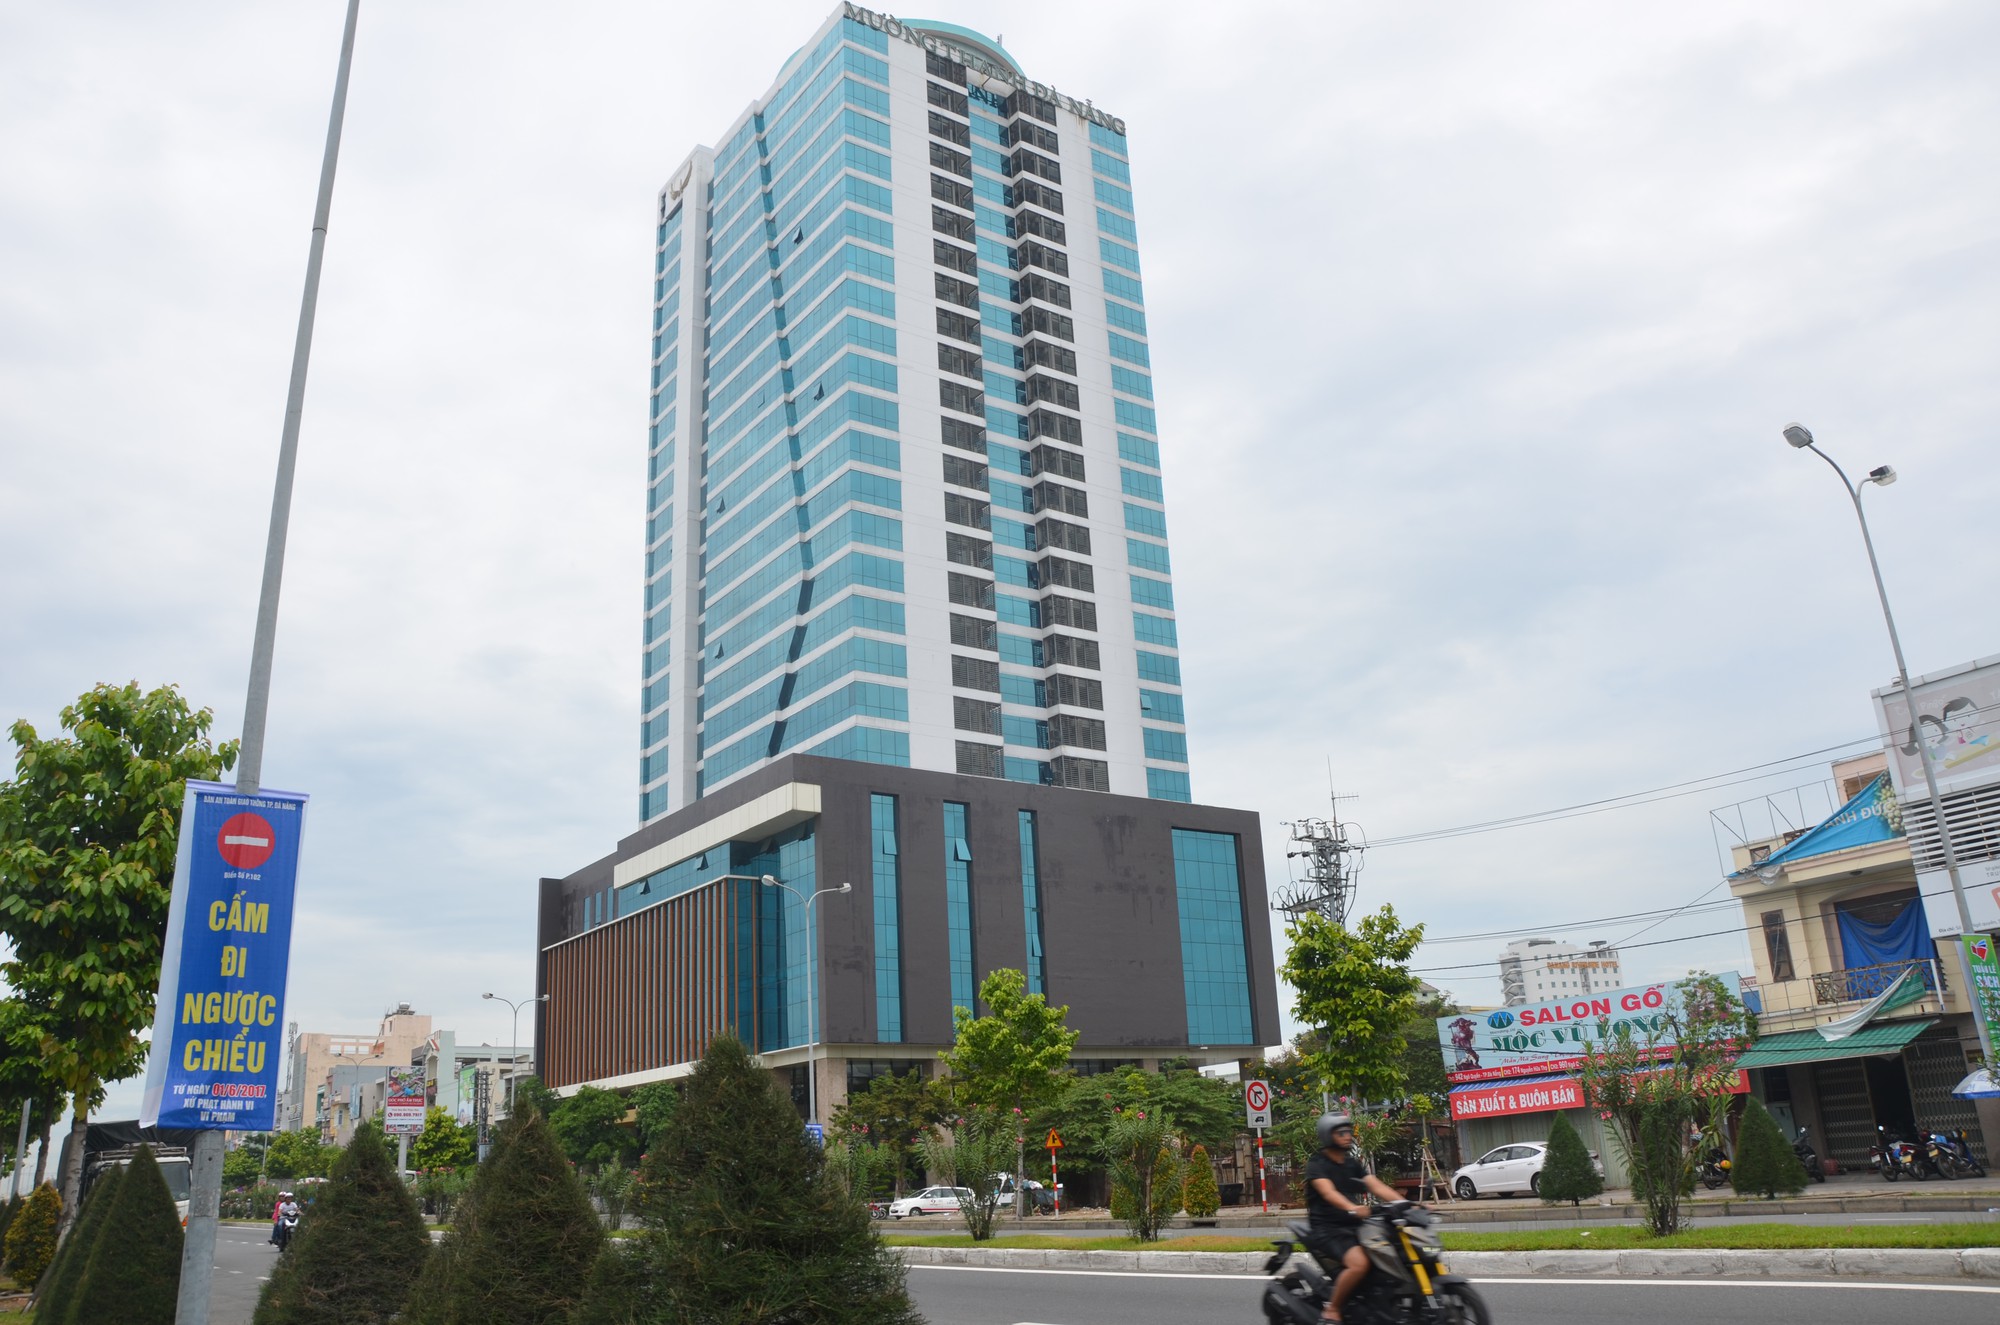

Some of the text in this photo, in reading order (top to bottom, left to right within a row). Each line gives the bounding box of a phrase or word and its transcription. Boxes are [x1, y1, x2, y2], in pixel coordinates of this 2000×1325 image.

[844, 1, 937, 51] MƯỜNG
[208, 890, 270, 934] CẤM
[220, 945, 247, 978] ĐI
[182, 990, 277, 1028] NGƯỢC
[1519, 984, 1665, 1027] SALON GỖ
[1491, 1028, 1547, 1053] MỘC
[1551, 1020, 1589, 1044] VŨ
[186, 1083, 210, 1095] NGÀY
[197, 1098, 219, 1111] PHẠT
[220, 1098, 243, 1110] HÀNH
[245, 1100, 254, 1111] VI
[1456, 1085, 1576, 1115] SẢN XUẤT & BUÔN BÁN
[200, 1111, 236, 1123] VI PHẠM
